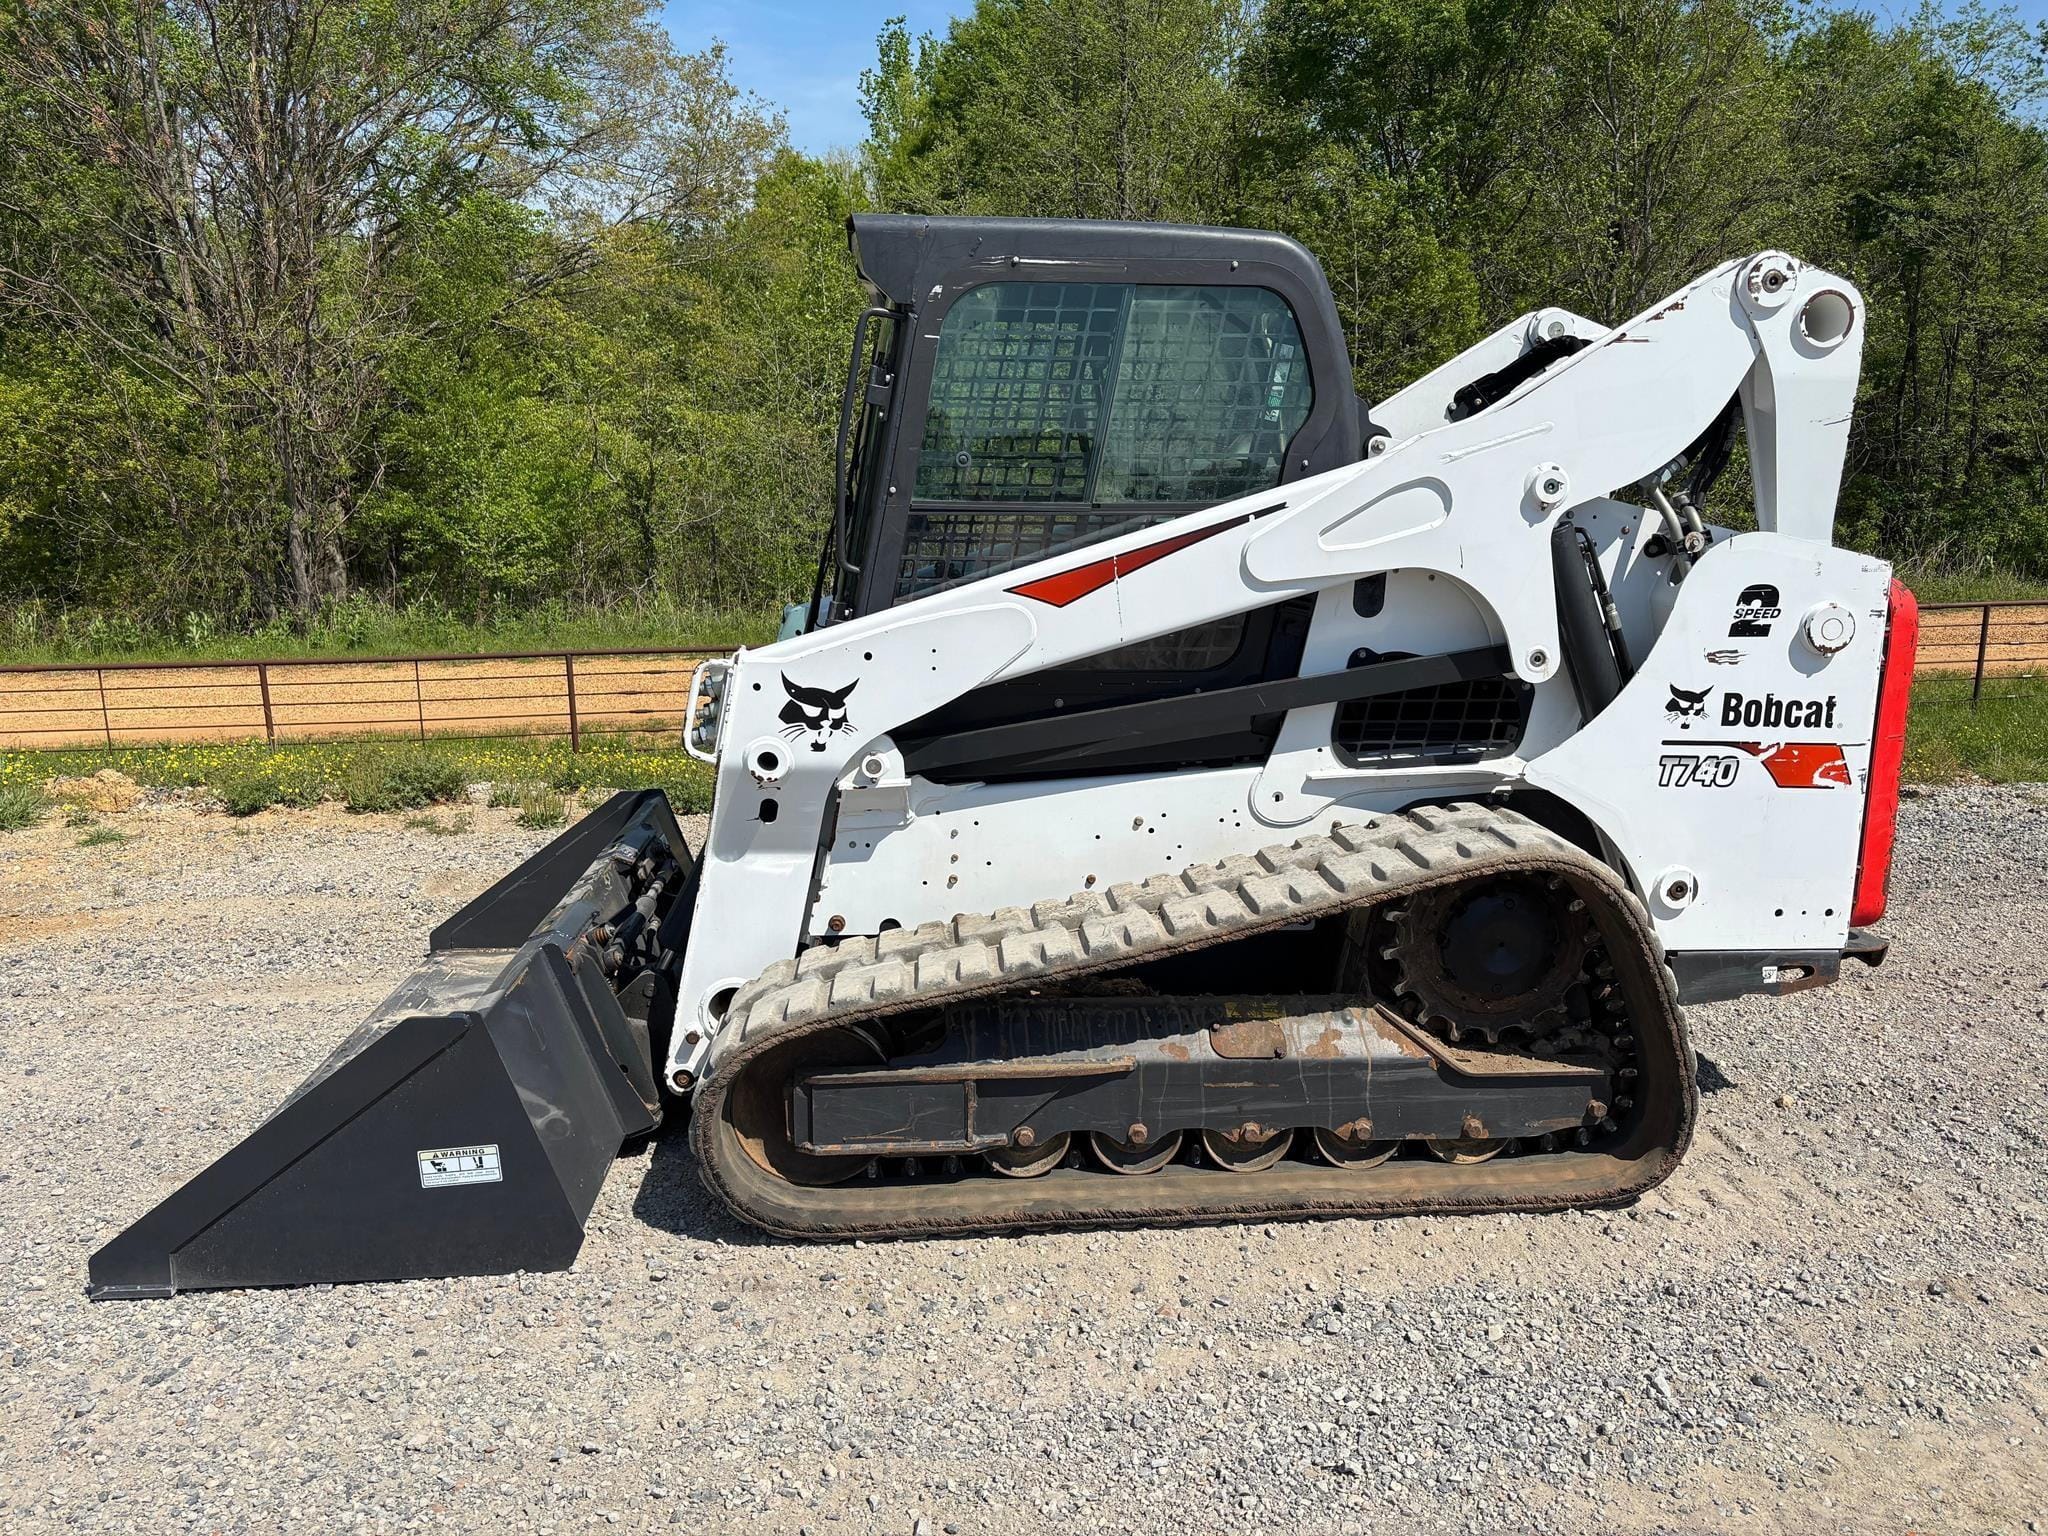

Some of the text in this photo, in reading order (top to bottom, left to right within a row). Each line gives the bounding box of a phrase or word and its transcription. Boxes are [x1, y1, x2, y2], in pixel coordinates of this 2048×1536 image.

[1728, 584, 1780, 637] 2
[1733, 608, 1781, 620] SPEED
[1721, 692, 1837, 728] Bobcat
[1658, 755, 1740, 787] T740
[441, 1148, 485, 1158] WARNING
